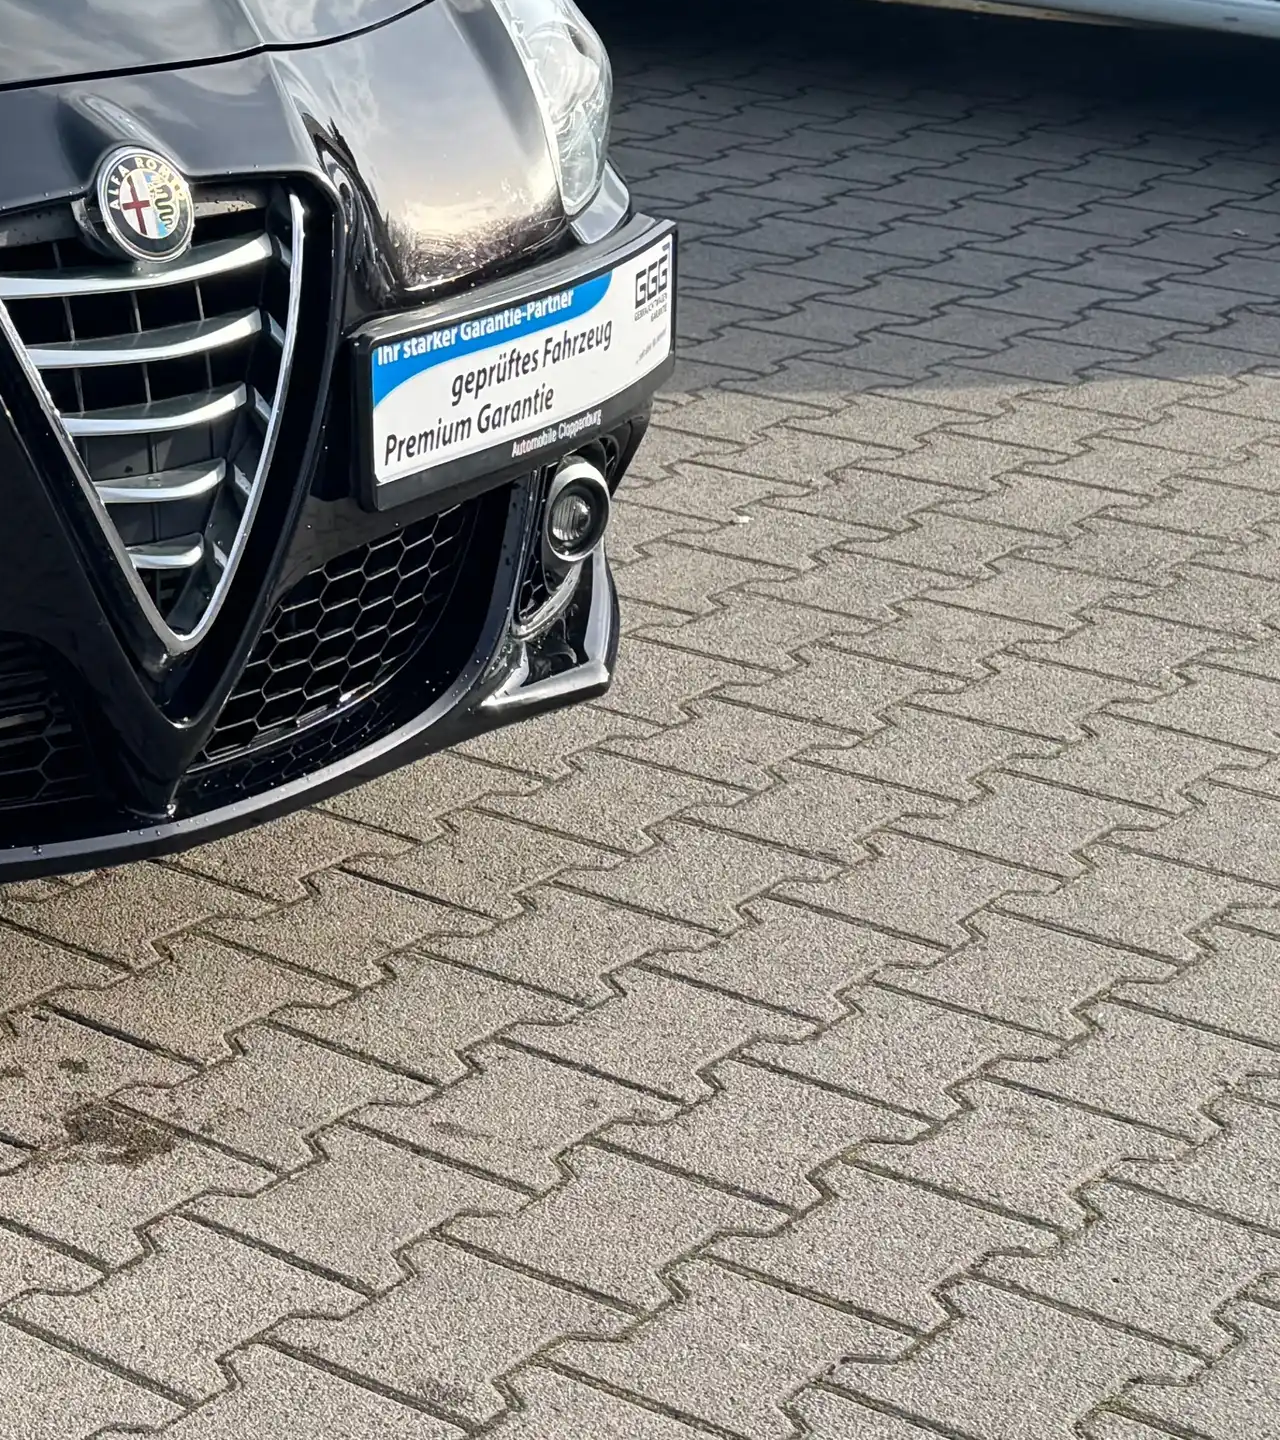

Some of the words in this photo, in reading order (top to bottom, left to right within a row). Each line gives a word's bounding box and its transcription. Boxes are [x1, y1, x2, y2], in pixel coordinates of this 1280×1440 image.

[107, 164, 131, 211] ALFA
[377, 345, 401, 366] Ihr
[403, 328, 458, 359] starker
[460, 290, 575, 341] Garantie-Partner
[451, 348, 540, 407] geprüftes
[542, 319, 613, 368] Fahrzeug
[384, 416, 473, 467] Premium
[476, 382, 555, 434] Garantie
[511, 427, 558, 458] Automobile
[558, 409, 603, 440] Cloppenburg
